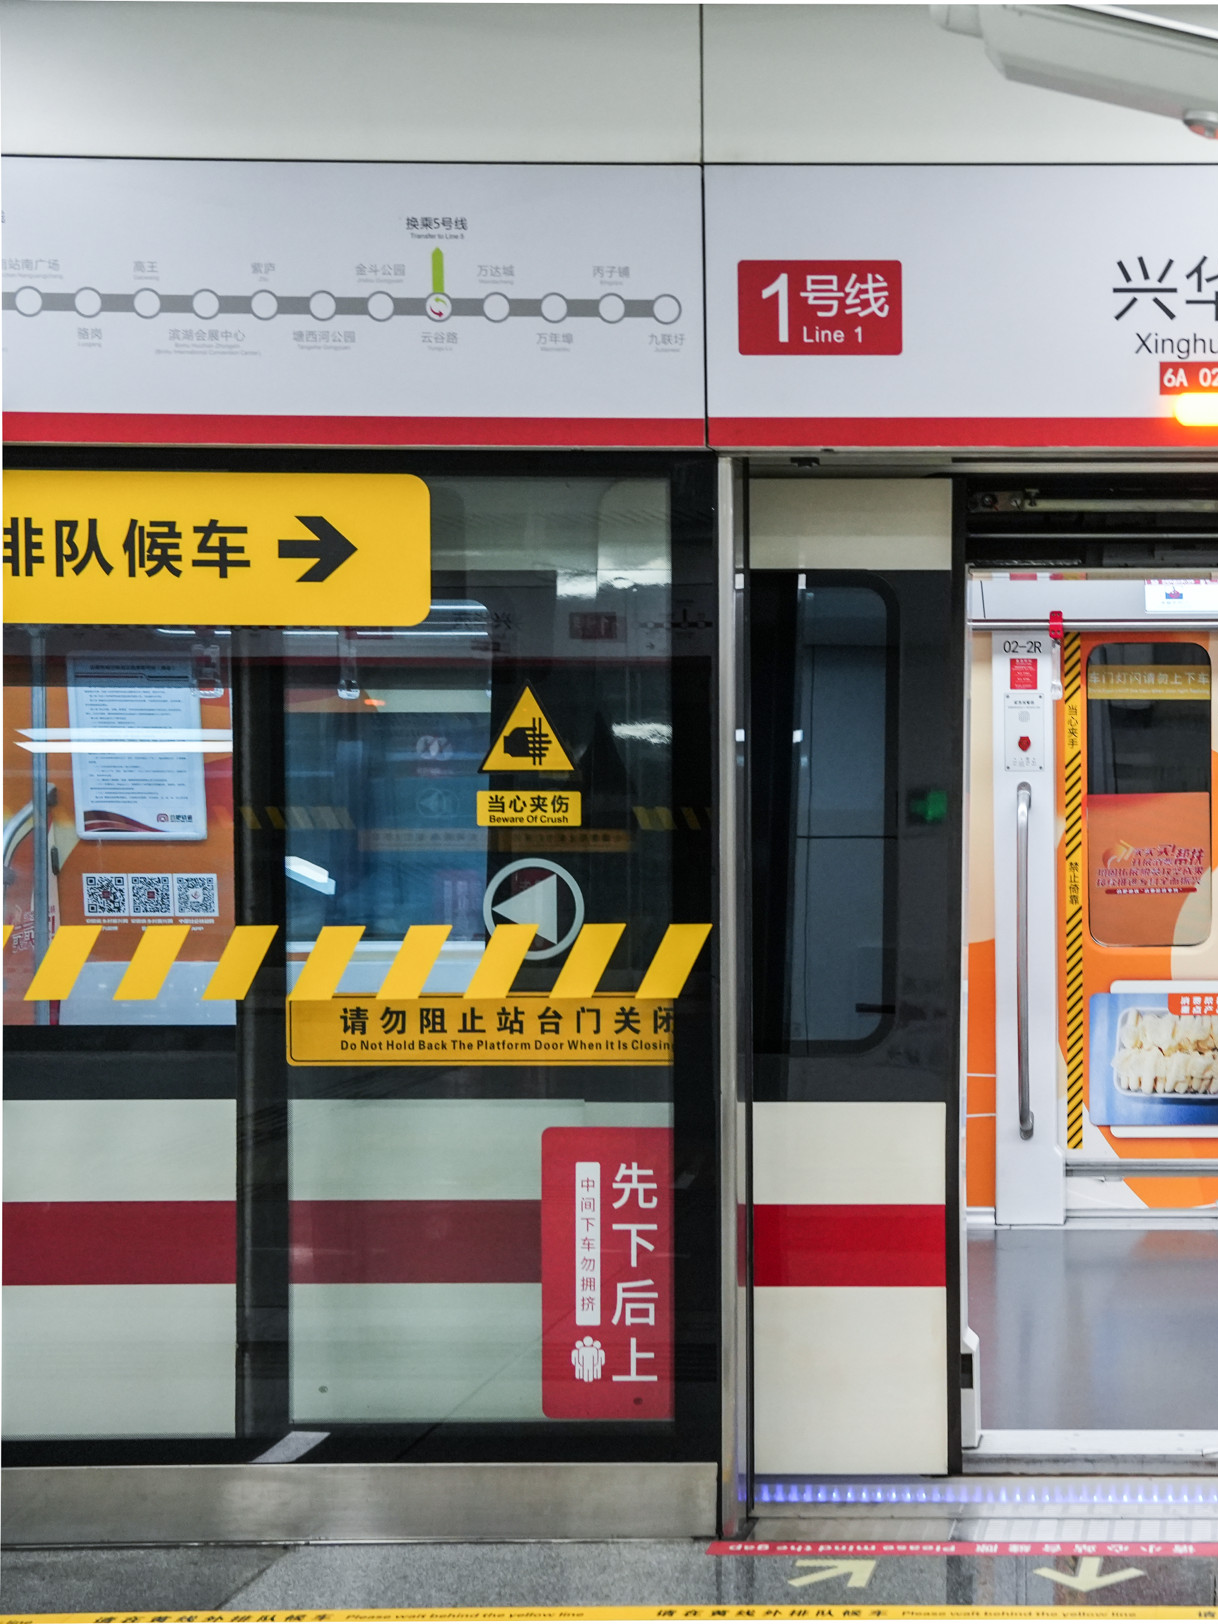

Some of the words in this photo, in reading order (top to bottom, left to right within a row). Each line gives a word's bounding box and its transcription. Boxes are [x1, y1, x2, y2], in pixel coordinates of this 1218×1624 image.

[406, 216, 468, 230] 换乘5号线
[133, 260, 159, 273] 高王
[355, 263, 406, 276] 金斗公园
[477, 264, 515, 277] 万达城
[761, 271, 890, 344] 1号线
[168, 328, 245, 342] 滨湖会展中心
[421, 332, 458, 344] 云谷路
[802, 325, 845, 344] Line
[853, 325, 864, 344] 1
[1162, 368, 1188, 388] 6A
[1003, 640, 1042, 654] 02-2R
[488, 795, 569, 813] 当心夹伤
[489, 815, 524, 823] Beware
[526, 815, 537, 823] Of
[540, 815, 568, 823] Crush
[1068, 861, 1080, 905] 禁止倚靠
[340, 1006, 674, 1035] 请勿阻止站台门关闭
[341, 1039, 357, 1051] Do
[360, 1039, 383, 1051] Not
[386, 1039, 415, 1051] Hold
[418, 1039, 447, 1051] Back
[450, 1039, 473, 1051] The
[477, 1039, 531, 1051] Platform
[534, 1039, 564, 1051] Door
[568, 1039, 602, 1051] When
[618, 1039, 628, 1051] Is
[580, 1177, 596, 1312] 中间下车勿拥挤
[612, 1161, 659, 1382] 先下后上
